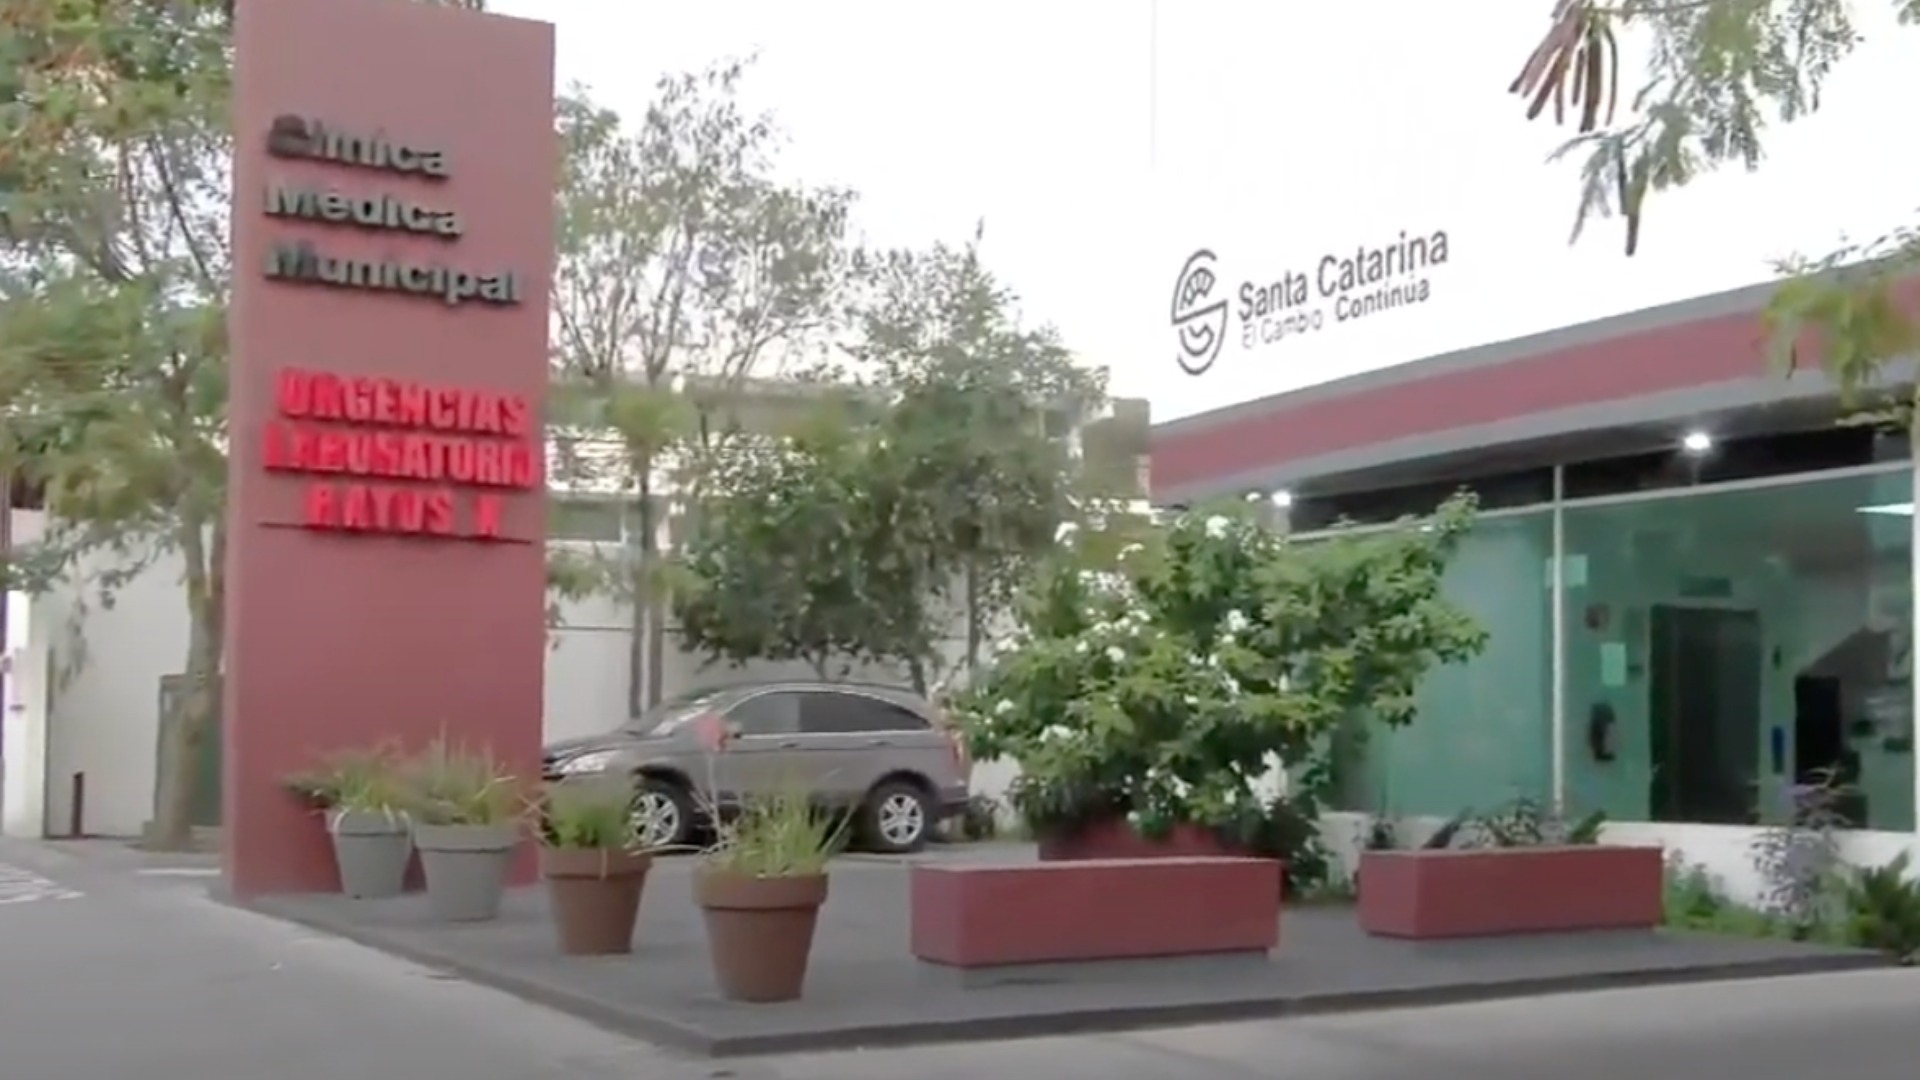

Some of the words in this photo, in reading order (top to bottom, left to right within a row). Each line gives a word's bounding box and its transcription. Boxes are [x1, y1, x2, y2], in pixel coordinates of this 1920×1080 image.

[263, 242, 522, 307] Municipal
[1238, 270, 1308, 322] Santa
[1317, 230, 1448, 297] Catarina
[1261, 308, 1324, 344] Cambo
[276, 369, 531, 435] URGENCIAS
[308, 484, 455, 538] RAYOS
